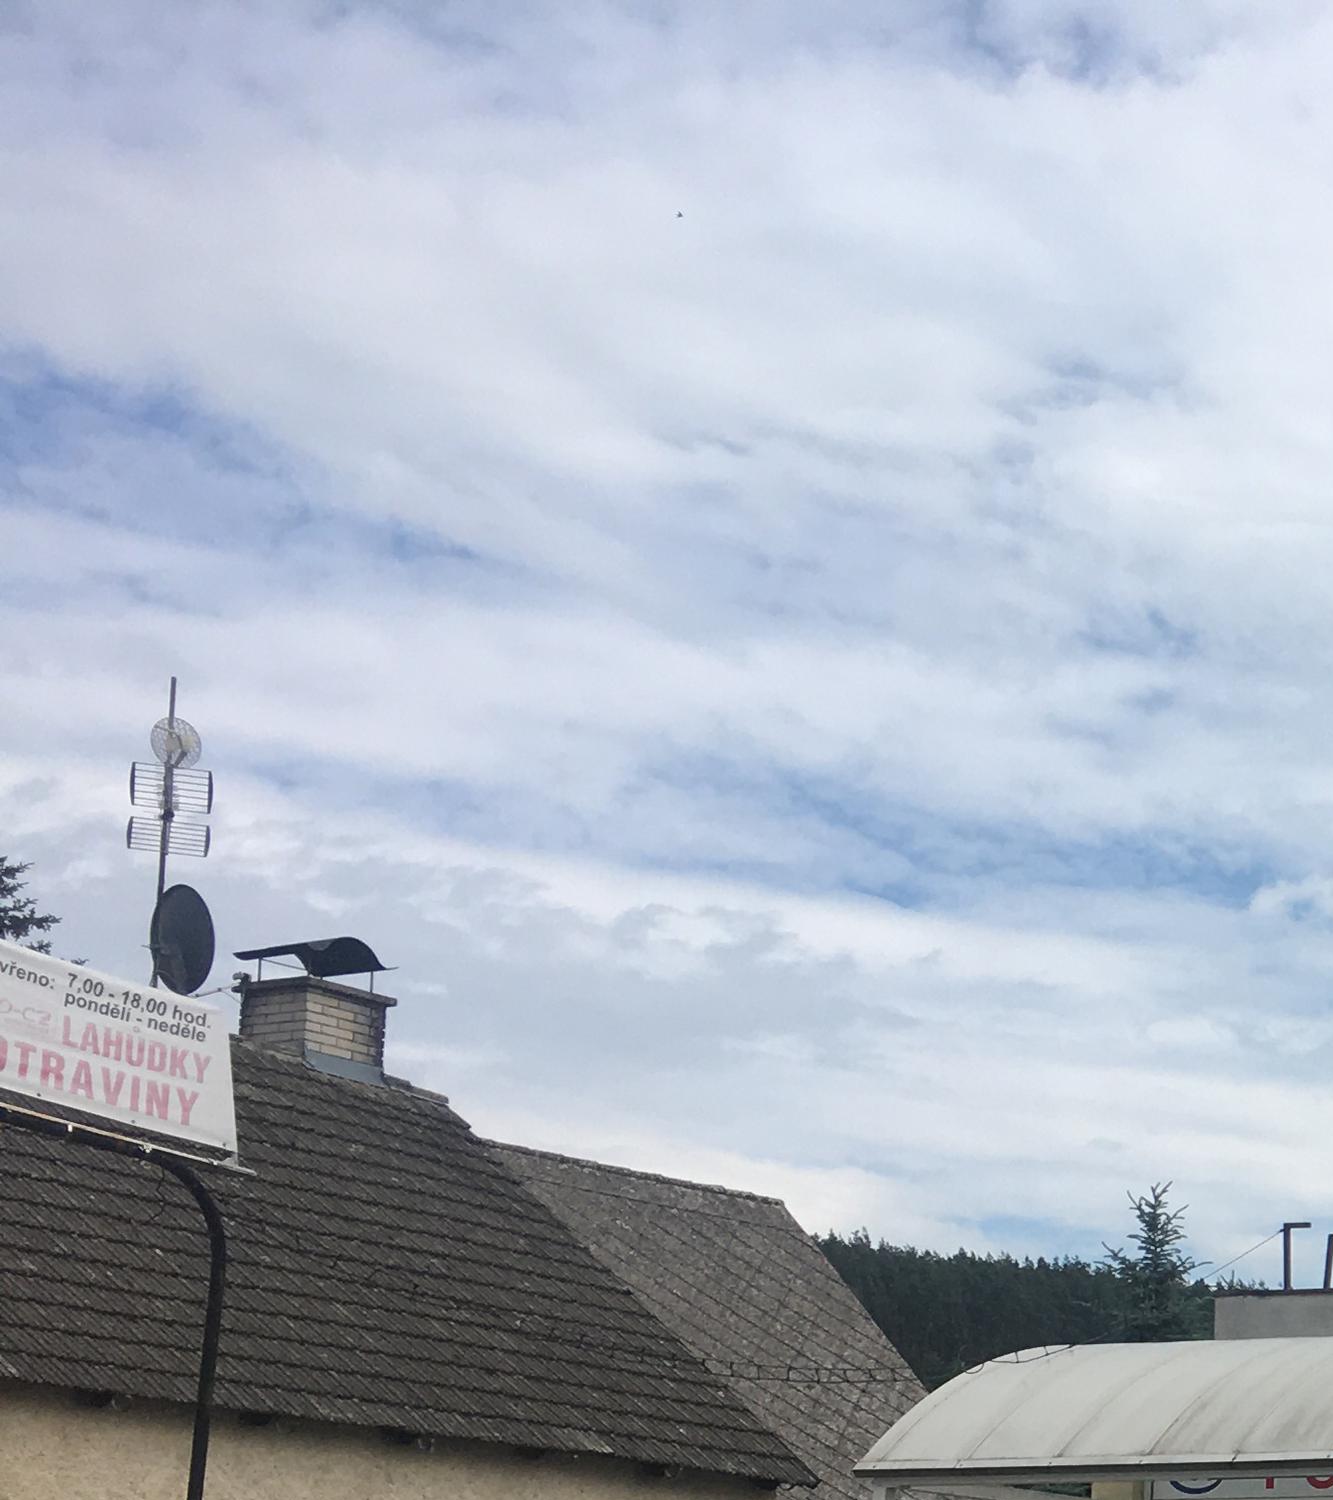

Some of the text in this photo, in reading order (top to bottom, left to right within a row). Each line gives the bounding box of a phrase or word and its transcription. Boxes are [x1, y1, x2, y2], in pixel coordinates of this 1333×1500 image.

[64, 992, 130, 1023] pondělí
[147, 1017, 206, 1042] neděle
[67, 972, 104, 998] 7,00
[121, 990, 167, 1017] 18,00
[172, 1002, 211, 1029] hod.
